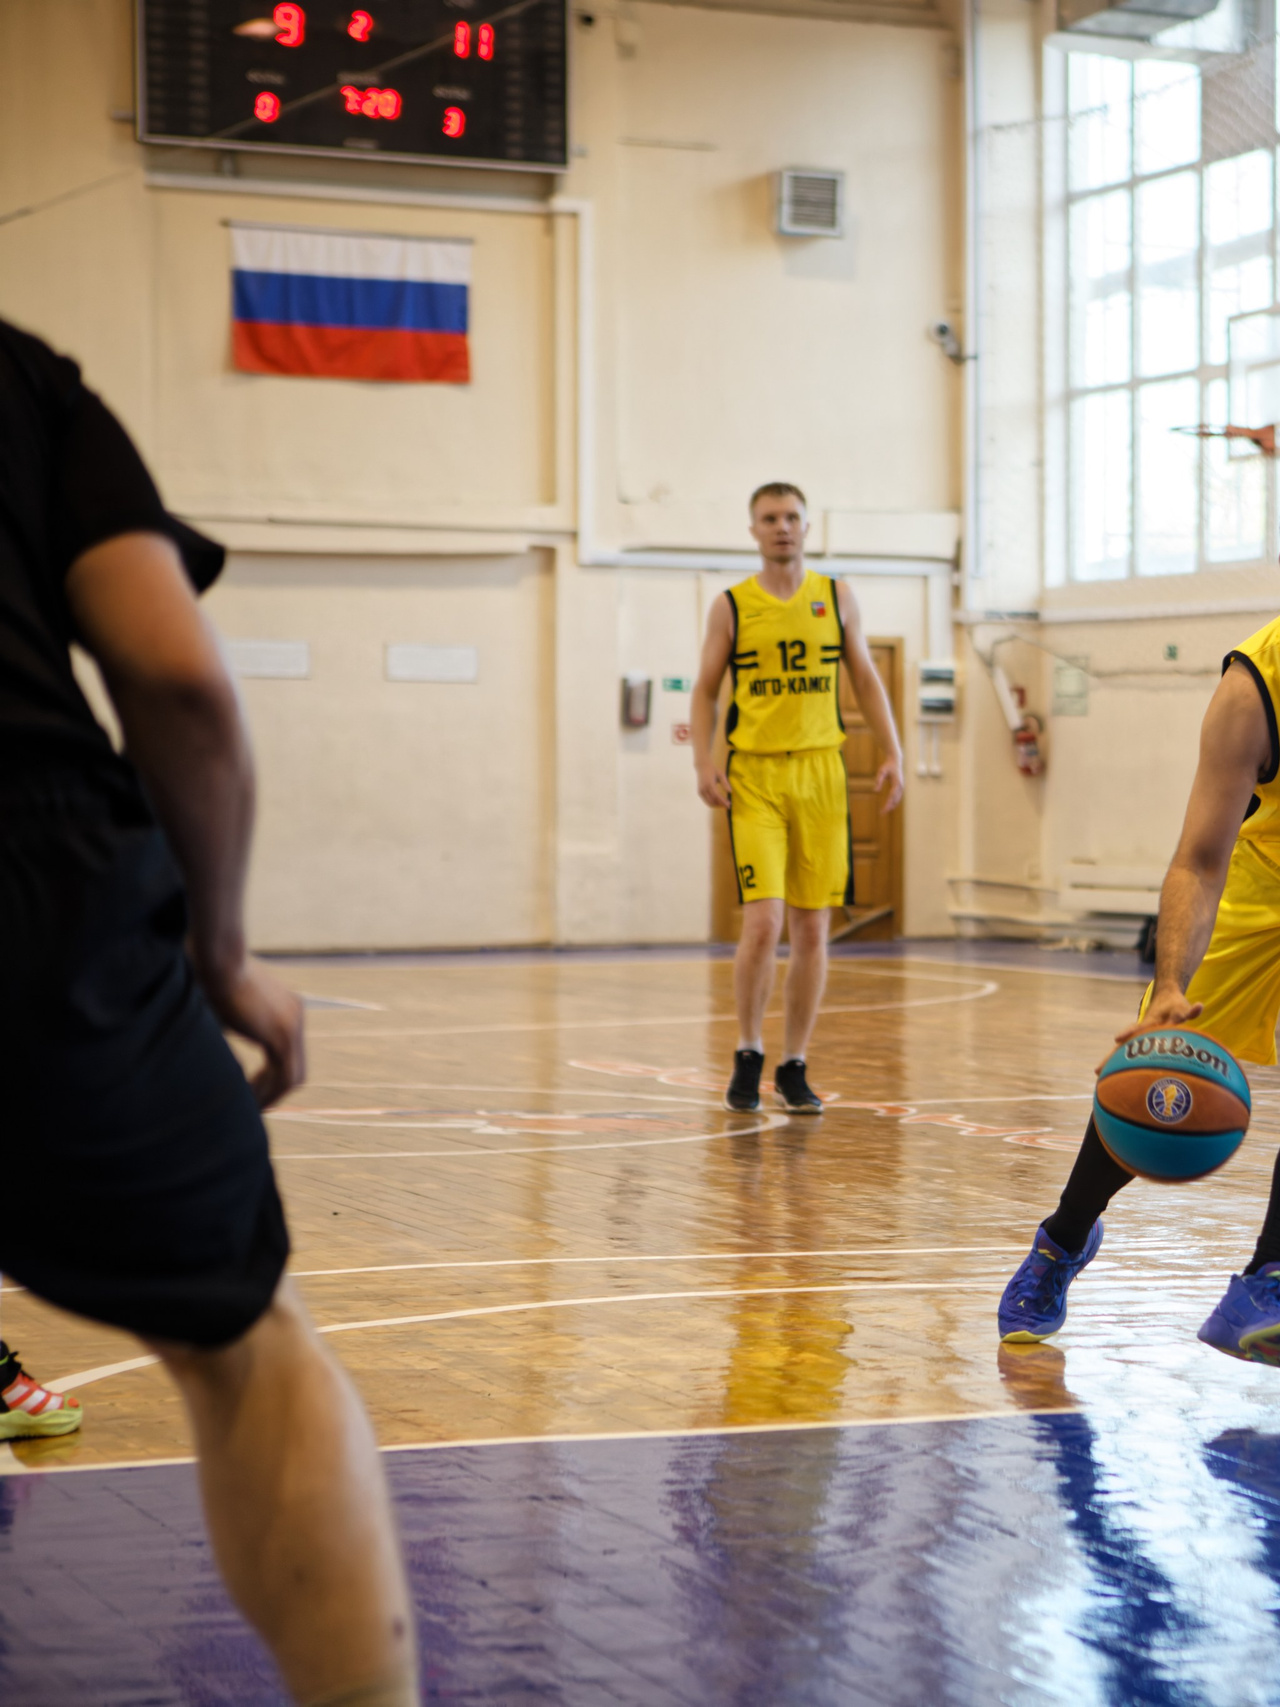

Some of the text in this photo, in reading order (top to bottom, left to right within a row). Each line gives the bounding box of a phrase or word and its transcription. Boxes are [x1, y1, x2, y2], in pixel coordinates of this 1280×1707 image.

[273, 2, 305, 47] 9
[347, 10, 373, 42] 2
[454, 21, 494, 61] 11
[442, 106, 466, 138] 3
[777, 640, 807, 672] 12
[738, 864, 757, 890] 12
[1125, 1036, 1231, 1080] Wilson
